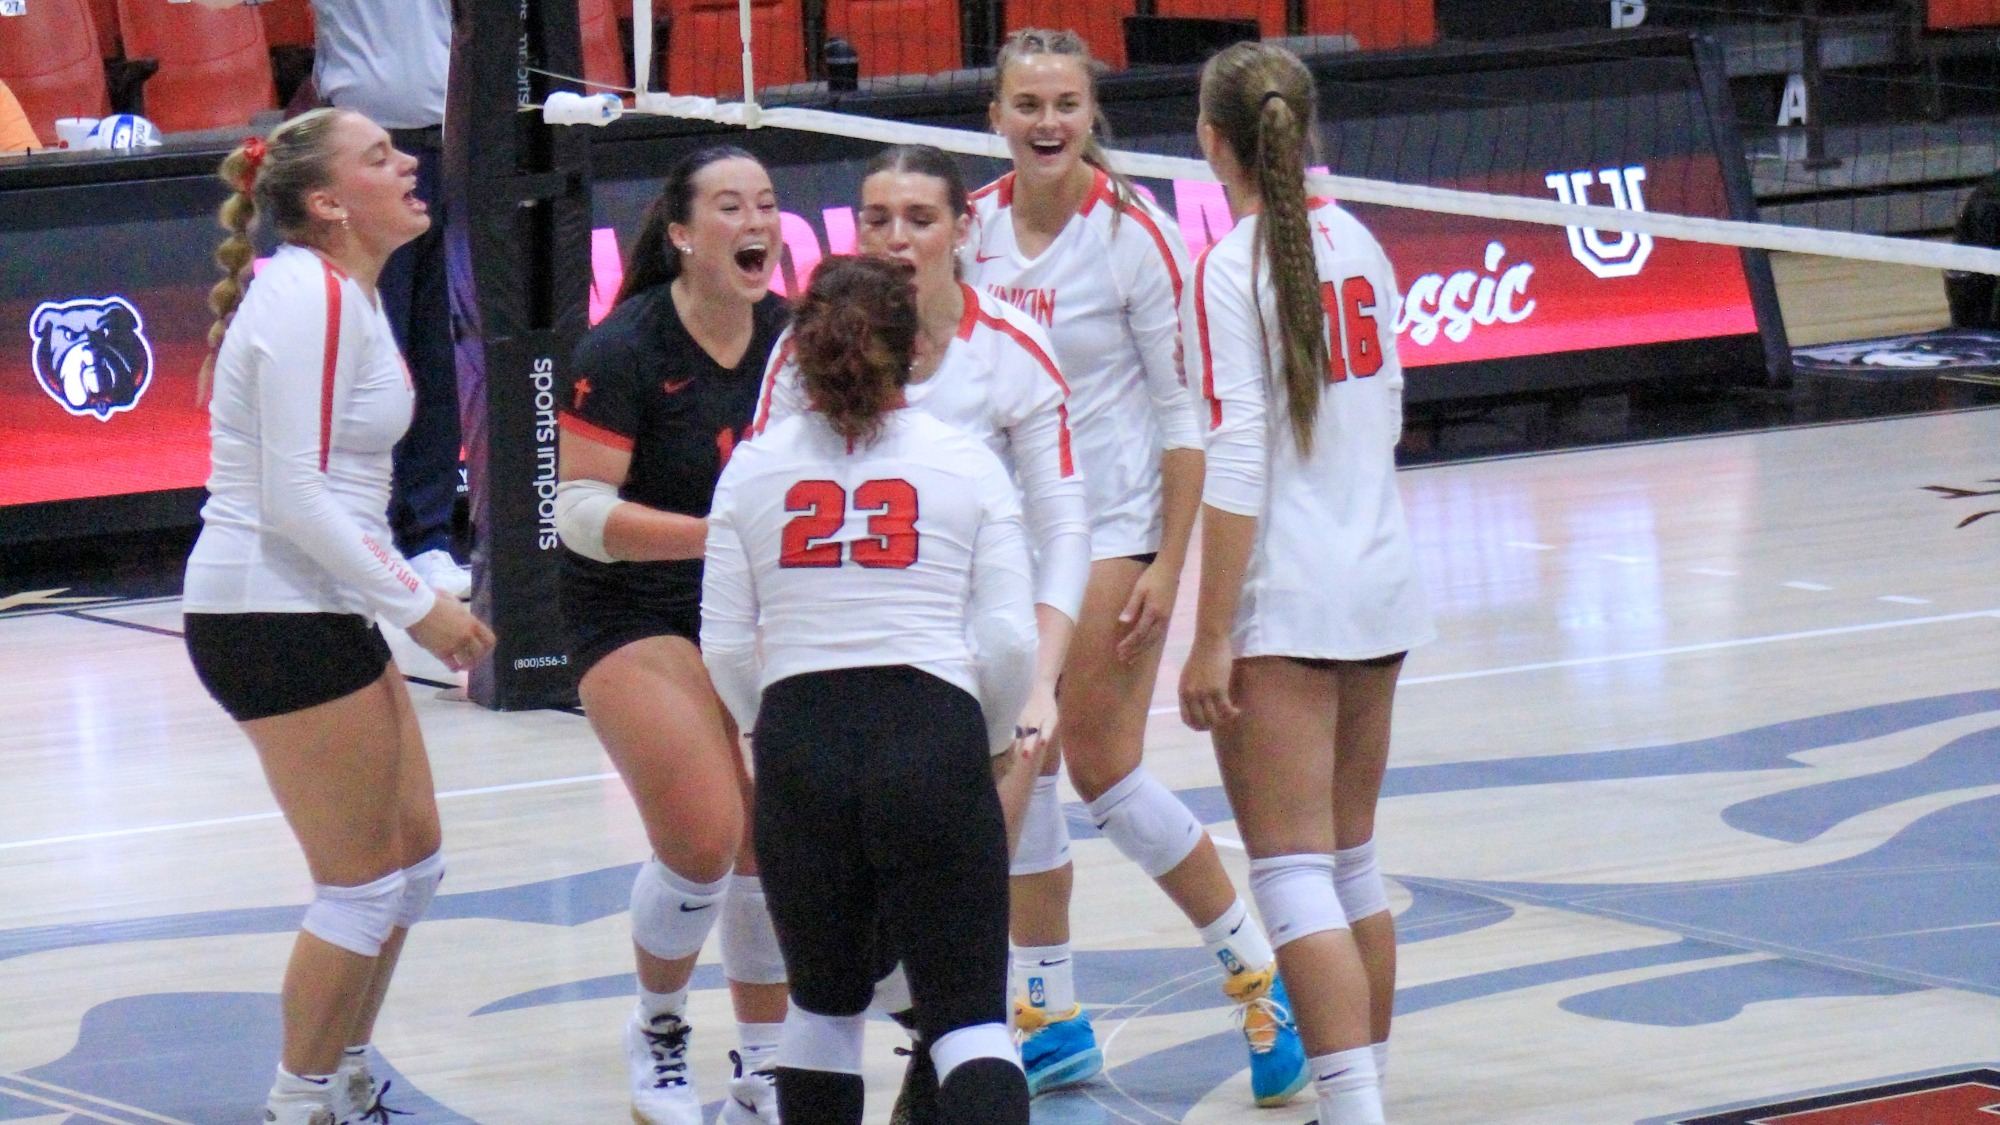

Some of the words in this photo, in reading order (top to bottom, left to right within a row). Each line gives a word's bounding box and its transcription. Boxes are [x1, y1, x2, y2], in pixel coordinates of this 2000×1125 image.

[1776, 73, 1807, 127] A
[1545, 165, 1654, 279] U
[987, 283, 1056, 329] ION
[1320, 275, 1384, 384] 16
[1389, 241, 1537, 346] ssic
[529, 358, 558, 443] sports
[532, 446, 559, 551] imports
[779, 478, 920, 569] 23
